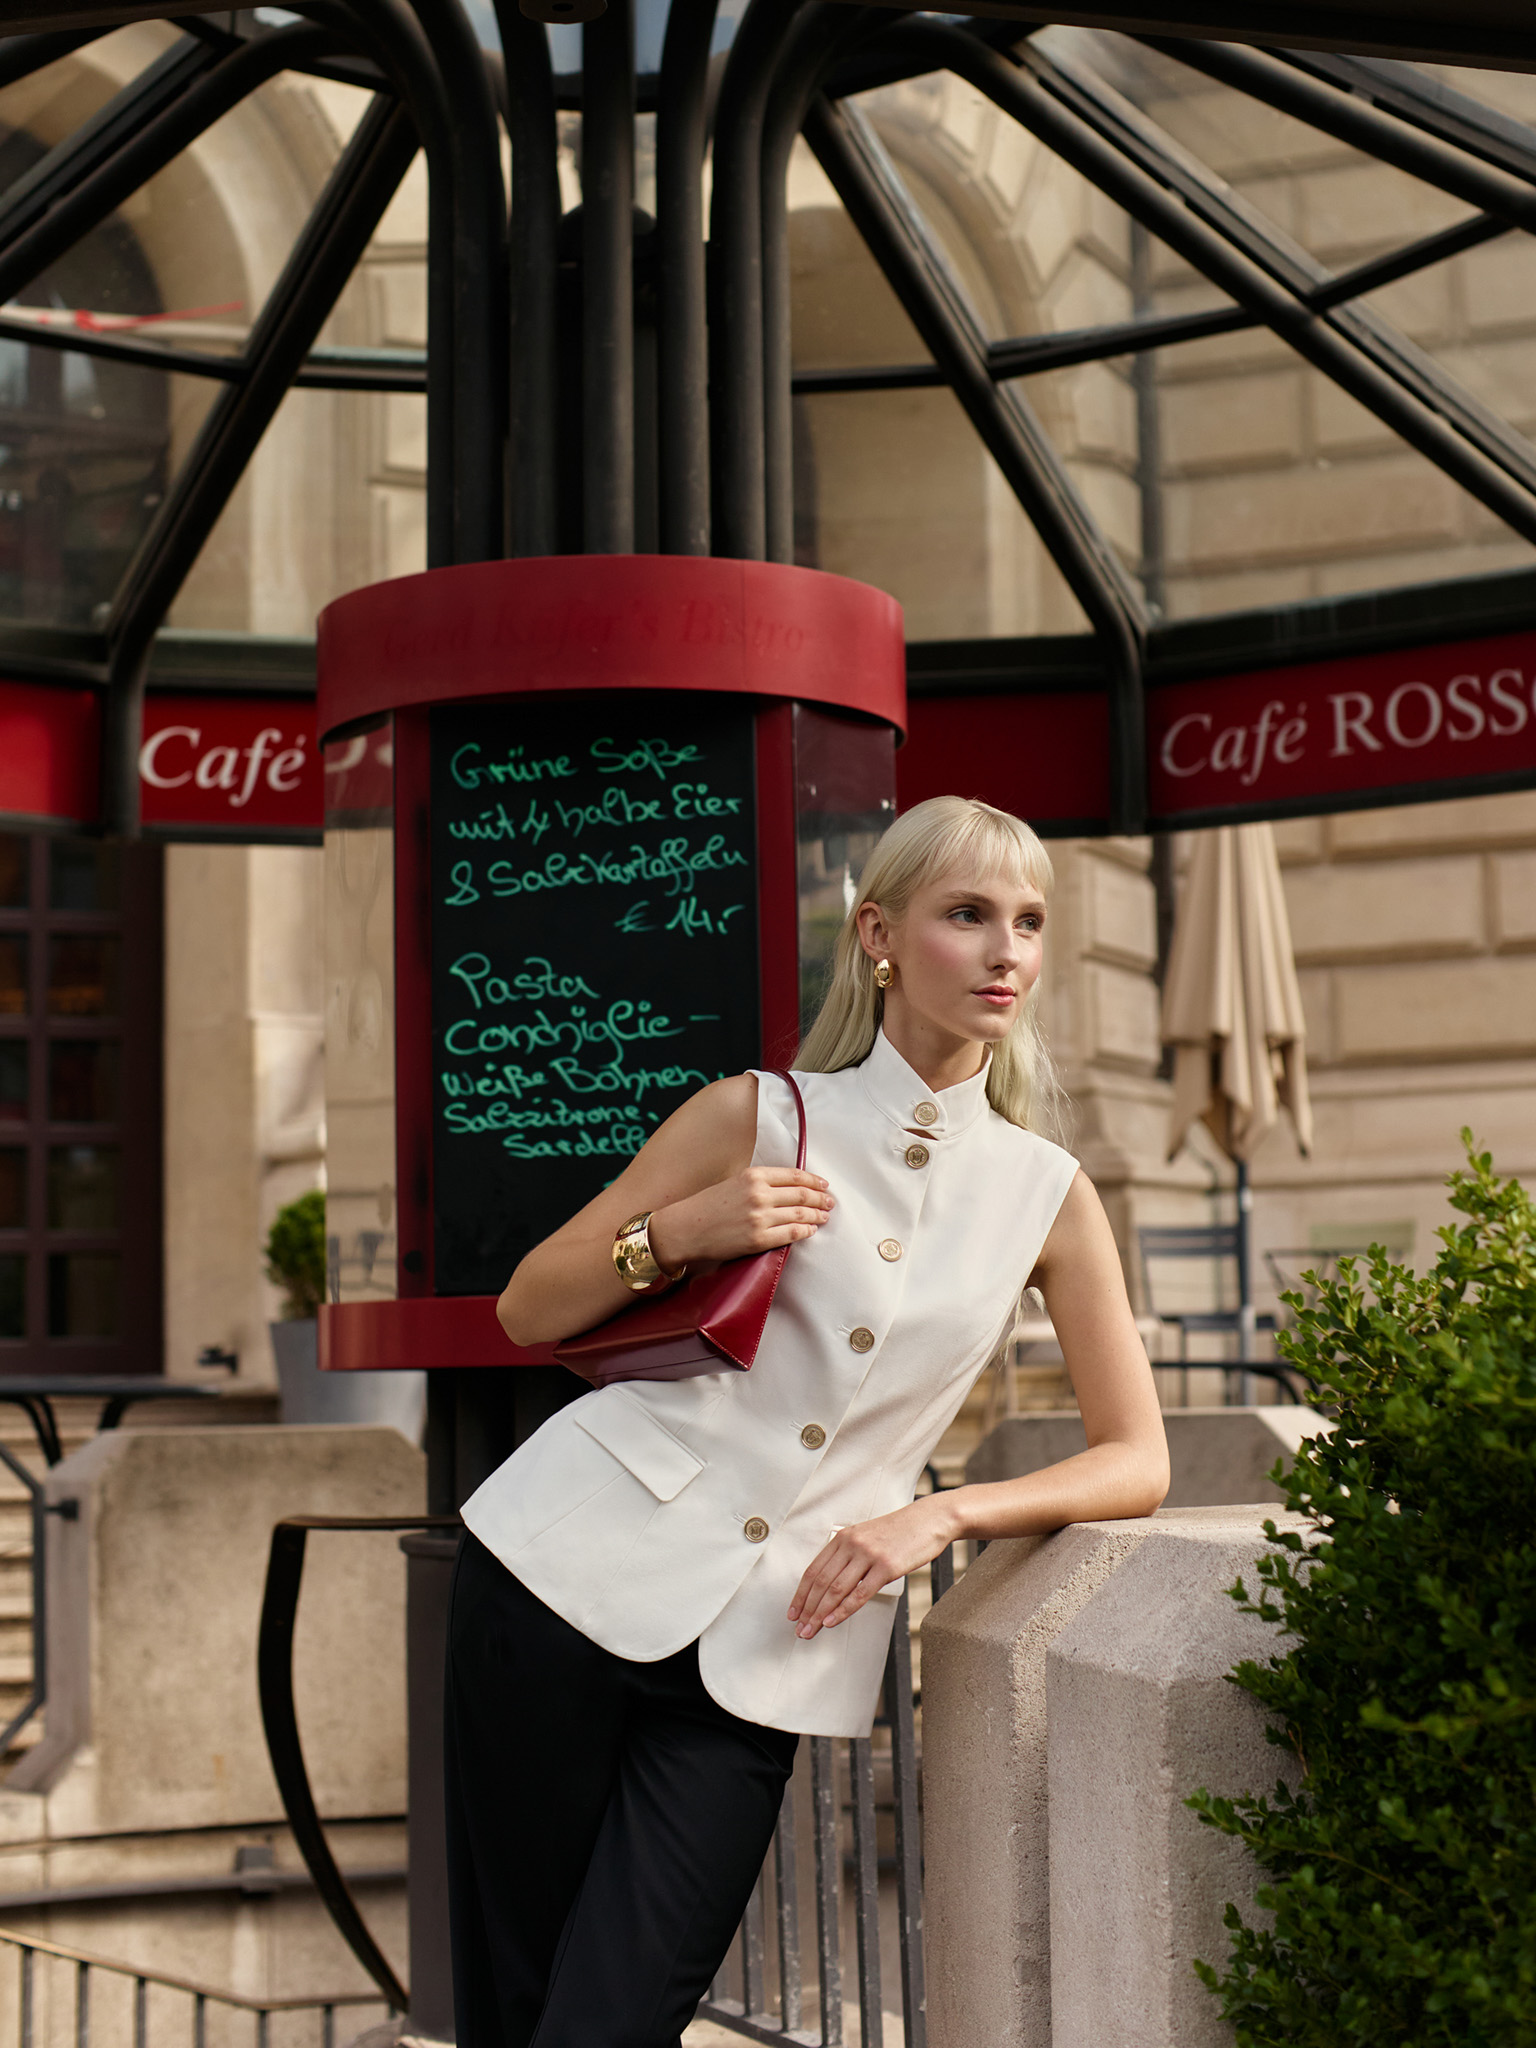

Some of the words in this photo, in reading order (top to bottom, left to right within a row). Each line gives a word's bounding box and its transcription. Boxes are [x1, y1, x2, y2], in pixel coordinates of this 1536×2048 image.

[1160, 701, 1308, 786] Café
[1327, 668, 1536, 758] ROSS
[138, 725, 306, 808] Café
[450, 742, 578, 790] Grüne
[589, 737, 706, 781] Soße
[448, 802, 517, 841] mit
[520, 799, 552, 847] 4
[553, 786, 667, 838] halbe
[671, 782, 742, 820] Eier
[486, 834, 749, 898] Salzkartoffeln
[613, 900, 656, 934] €
[448, 951, 601, 1010] Pasta
